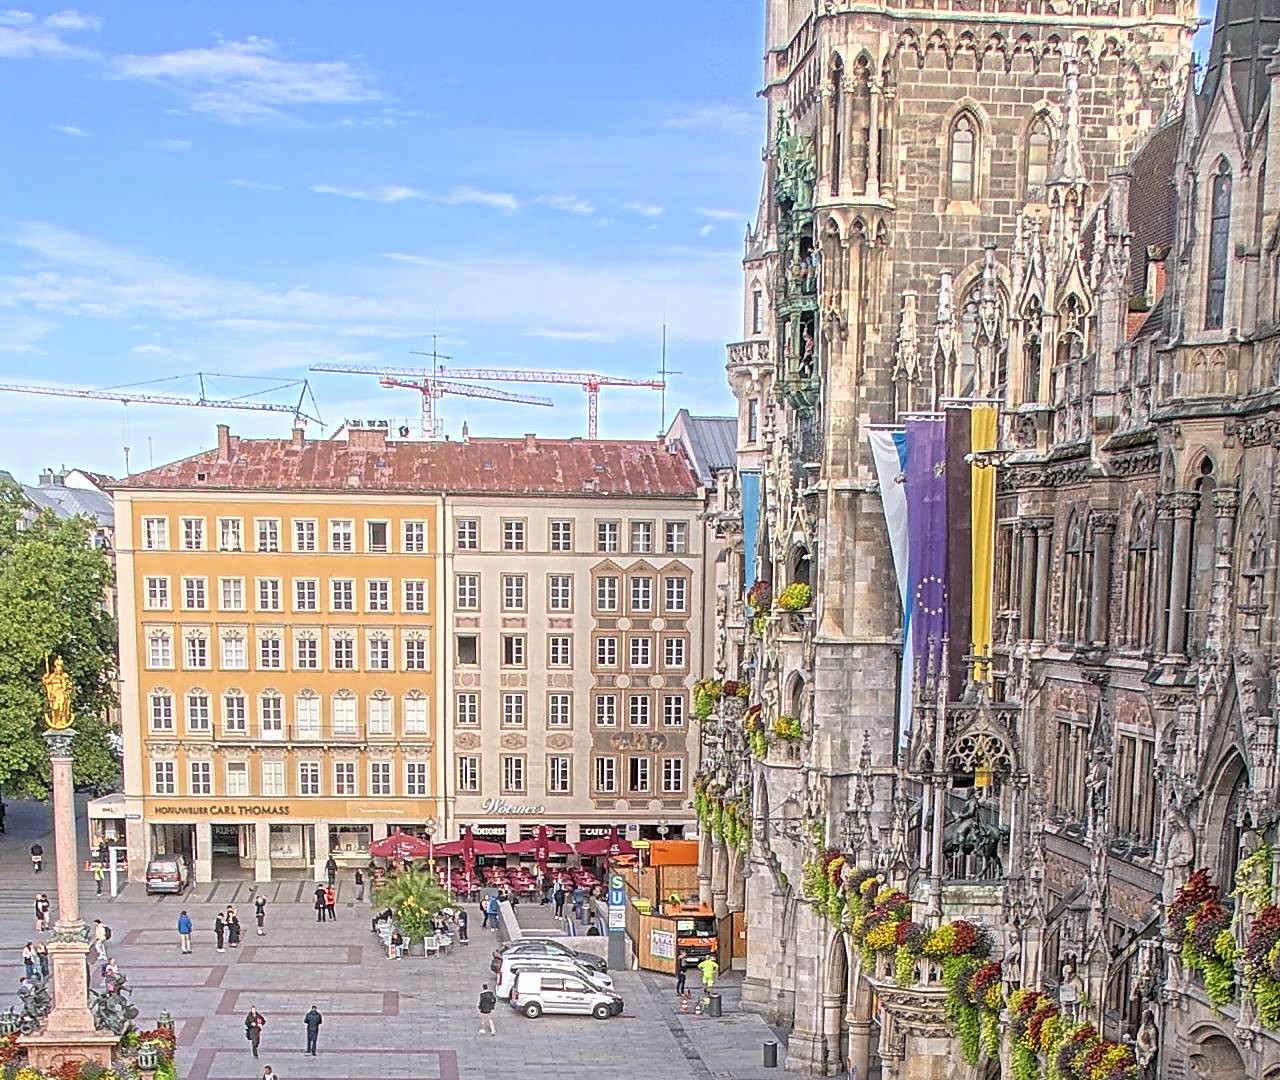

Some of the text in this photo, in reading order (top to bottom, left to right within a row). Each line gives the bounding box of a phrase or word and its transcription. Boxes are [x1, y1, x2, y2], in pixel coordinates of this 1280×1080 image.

[209, 805, 237, 816] CARL
[238, 805, 290, 816] THOMASS
[611, 876, 624, 890] S
[612, 892, 623, 905] U
